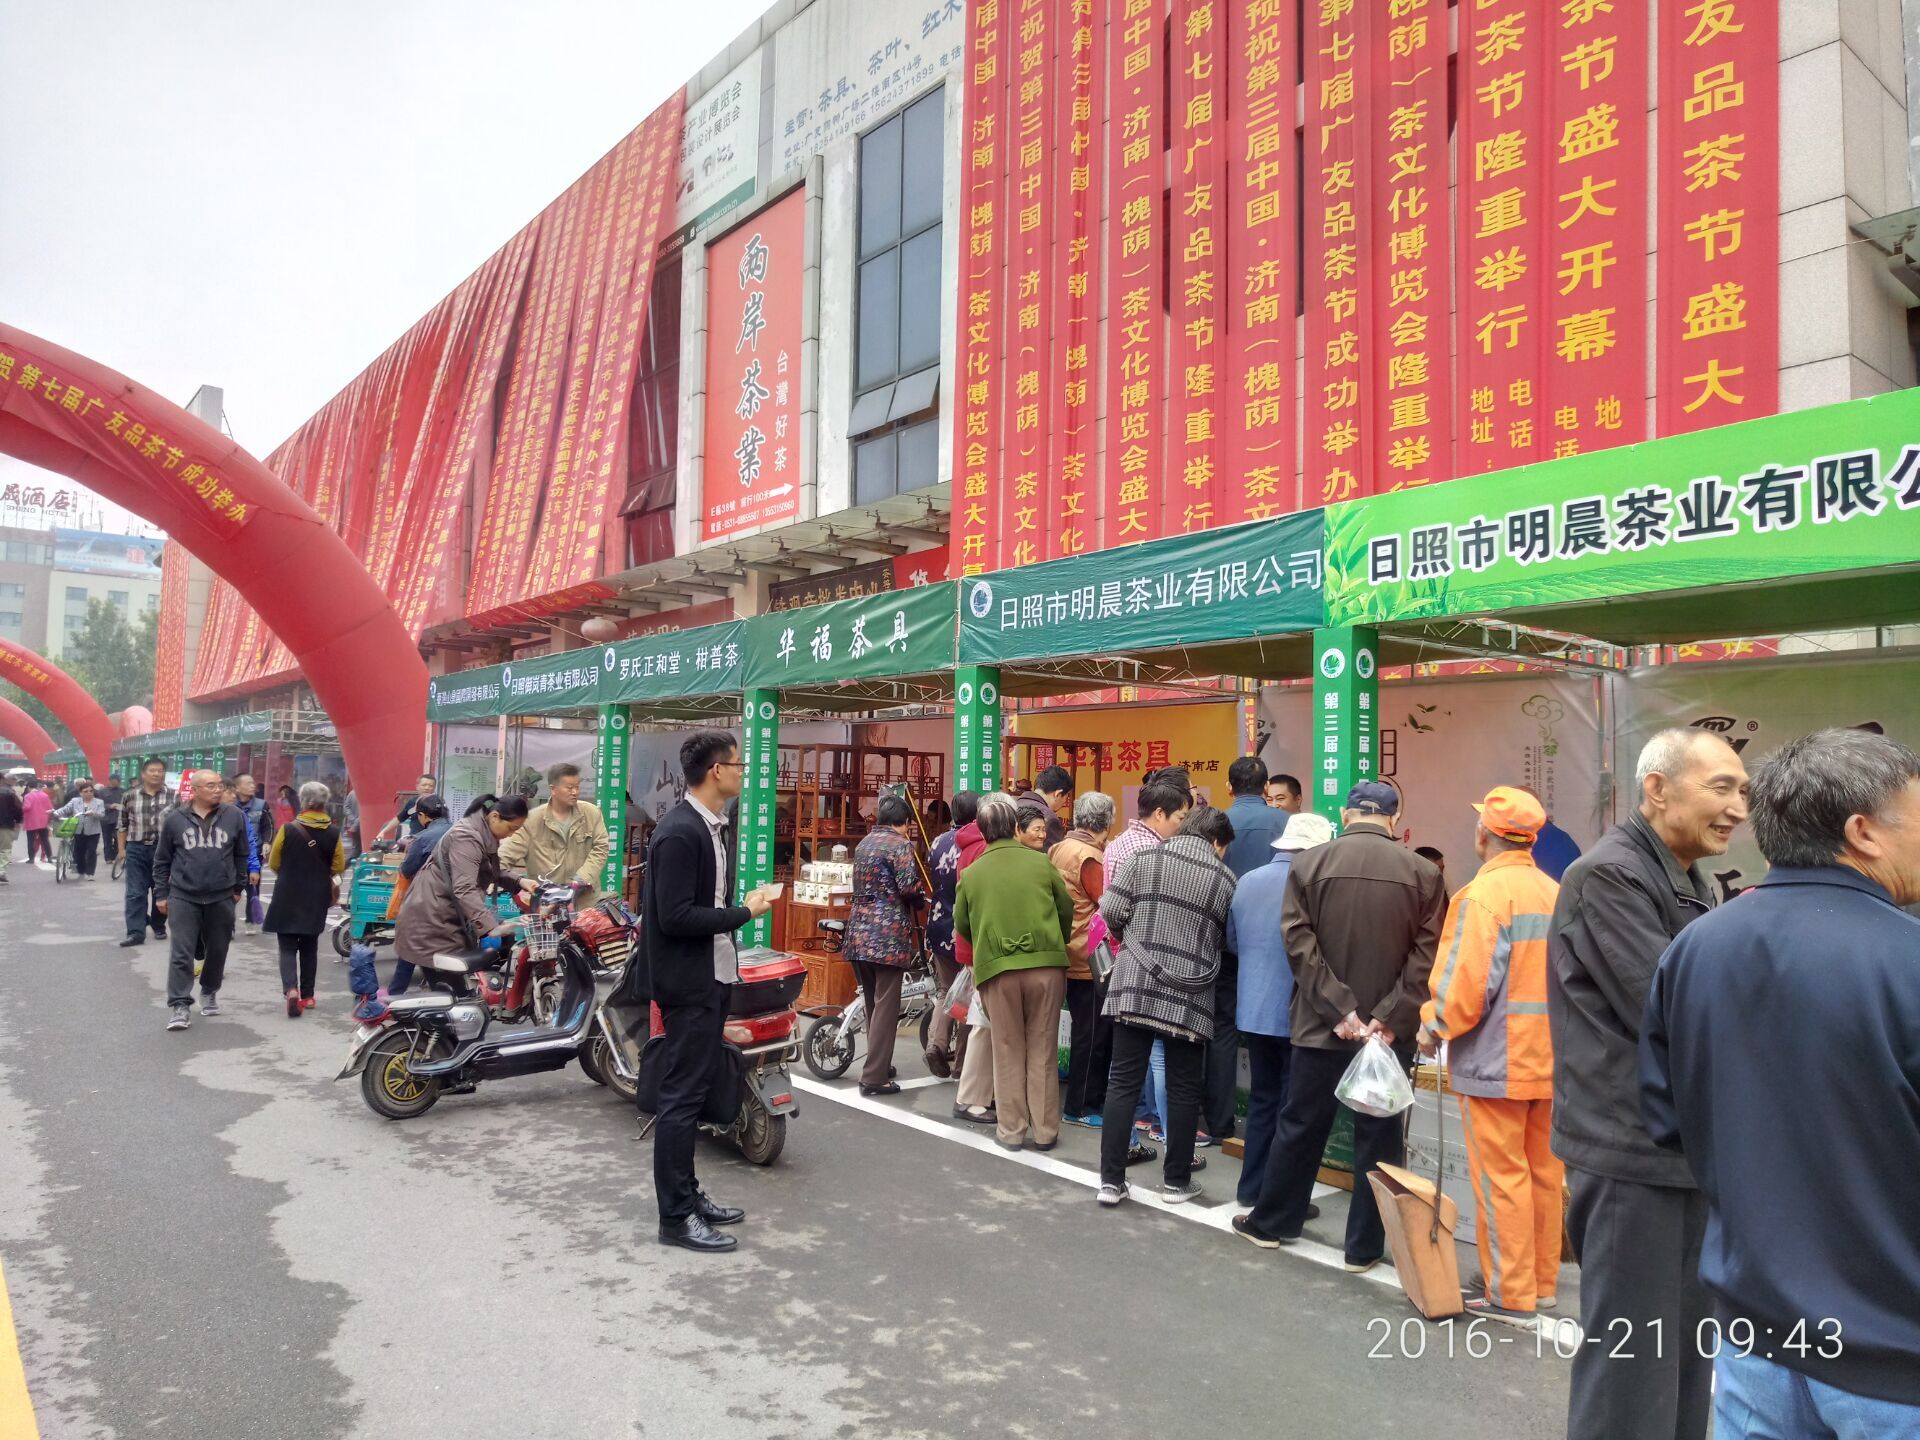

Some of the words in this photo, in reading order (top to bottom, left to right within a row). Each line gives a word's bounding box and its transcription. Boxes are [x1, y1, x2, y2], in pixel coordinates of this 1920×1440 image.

[1474, 0, 1528, 355] 茶节隆重举行
[999, 549, 1323, 634] 日照市明晨茶业有限公司
[776, 609, 910, 671] 华福茶具
